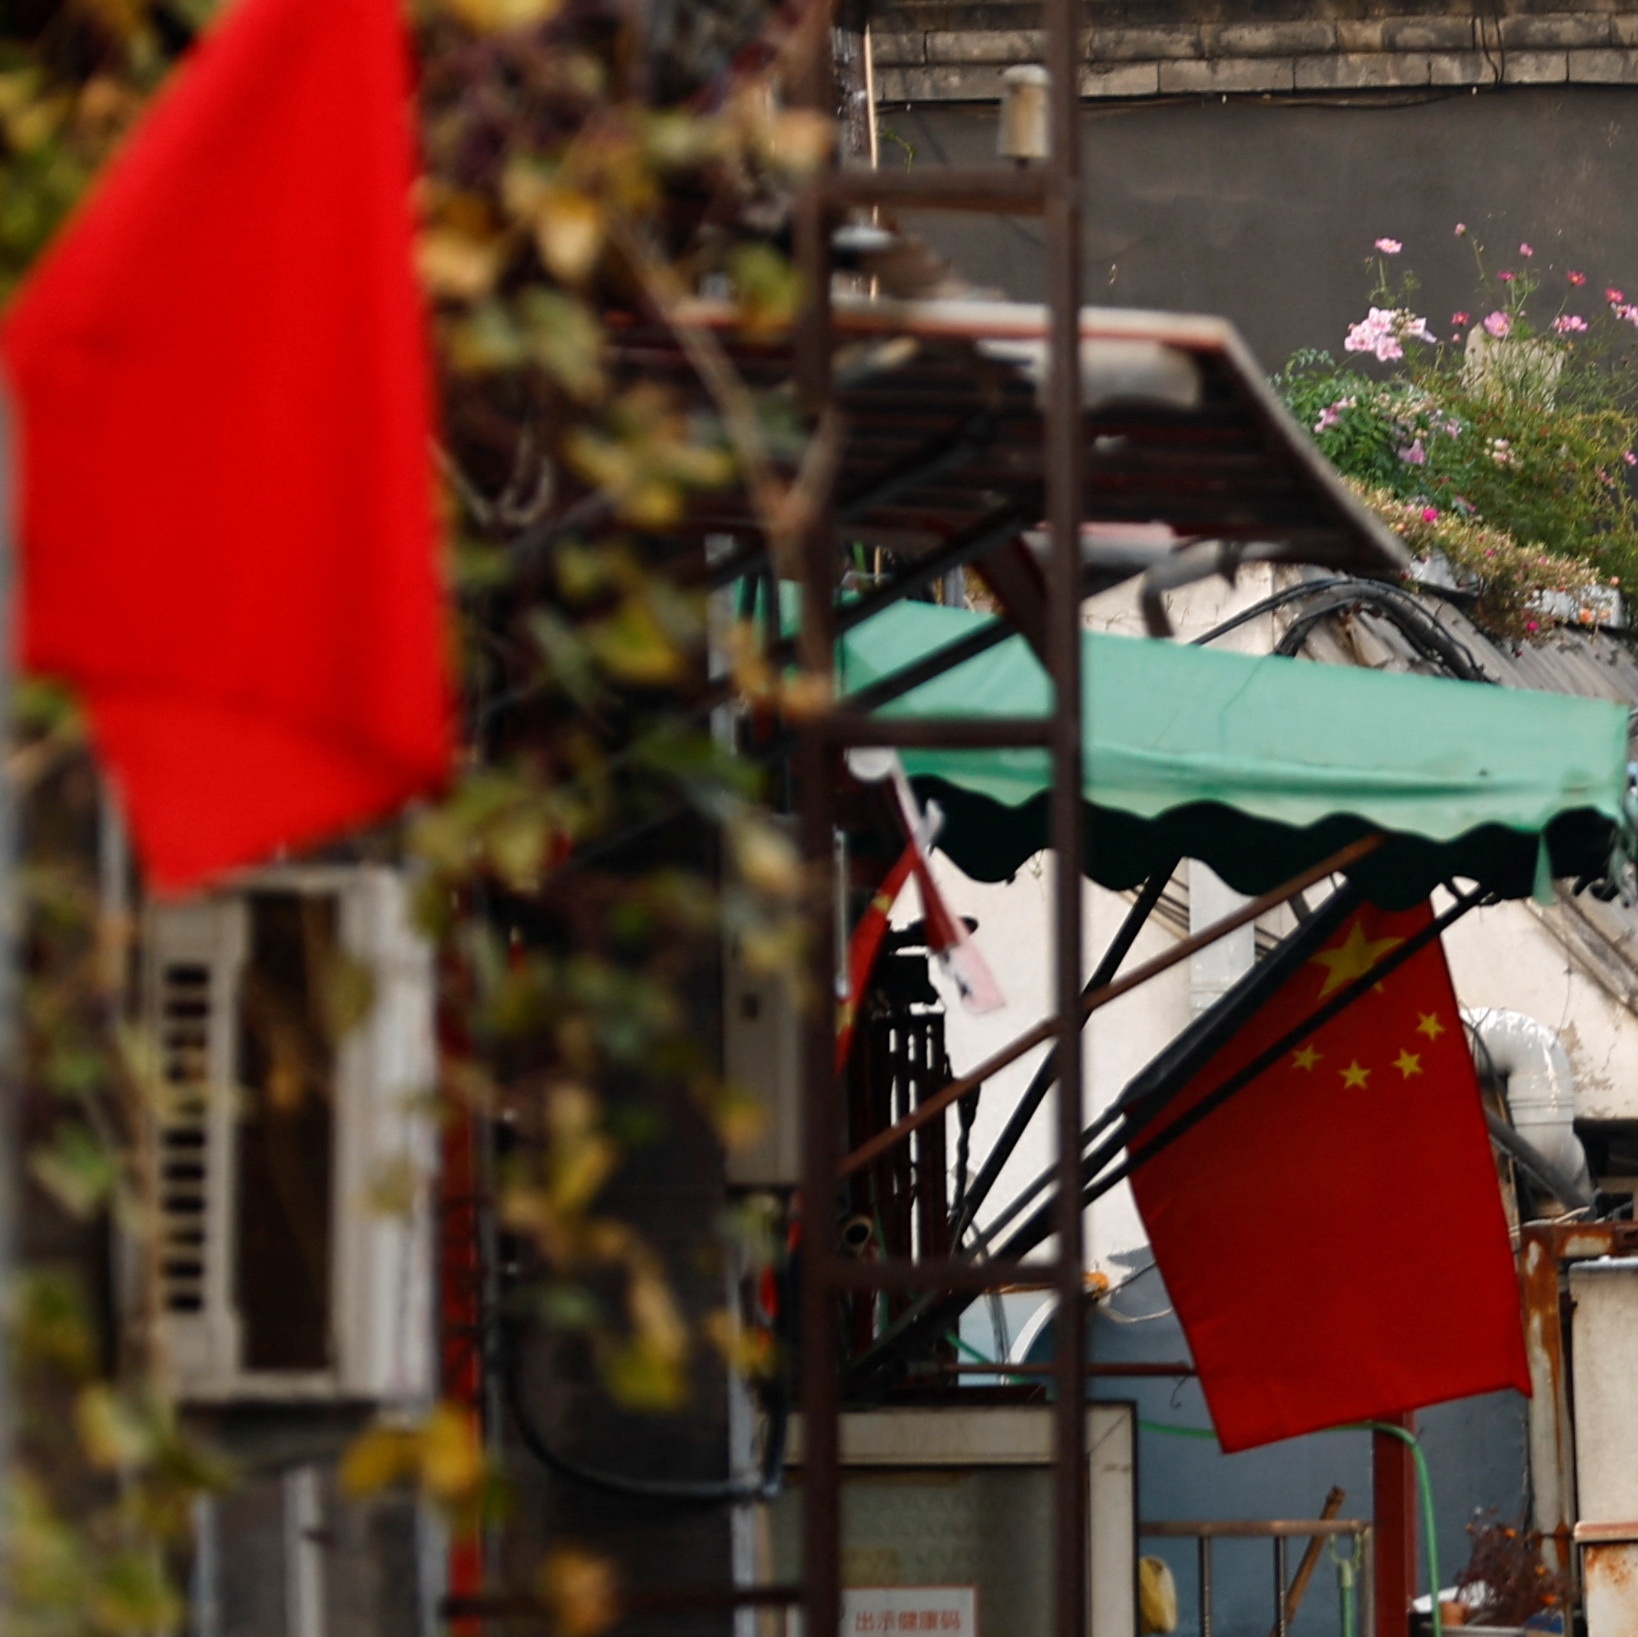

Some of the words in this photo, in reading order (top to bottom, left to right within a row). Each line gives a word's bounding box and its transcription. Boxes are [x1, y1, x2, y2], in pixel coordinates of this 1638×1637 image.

[855, 1610, 961, 1632] 出示健康码
